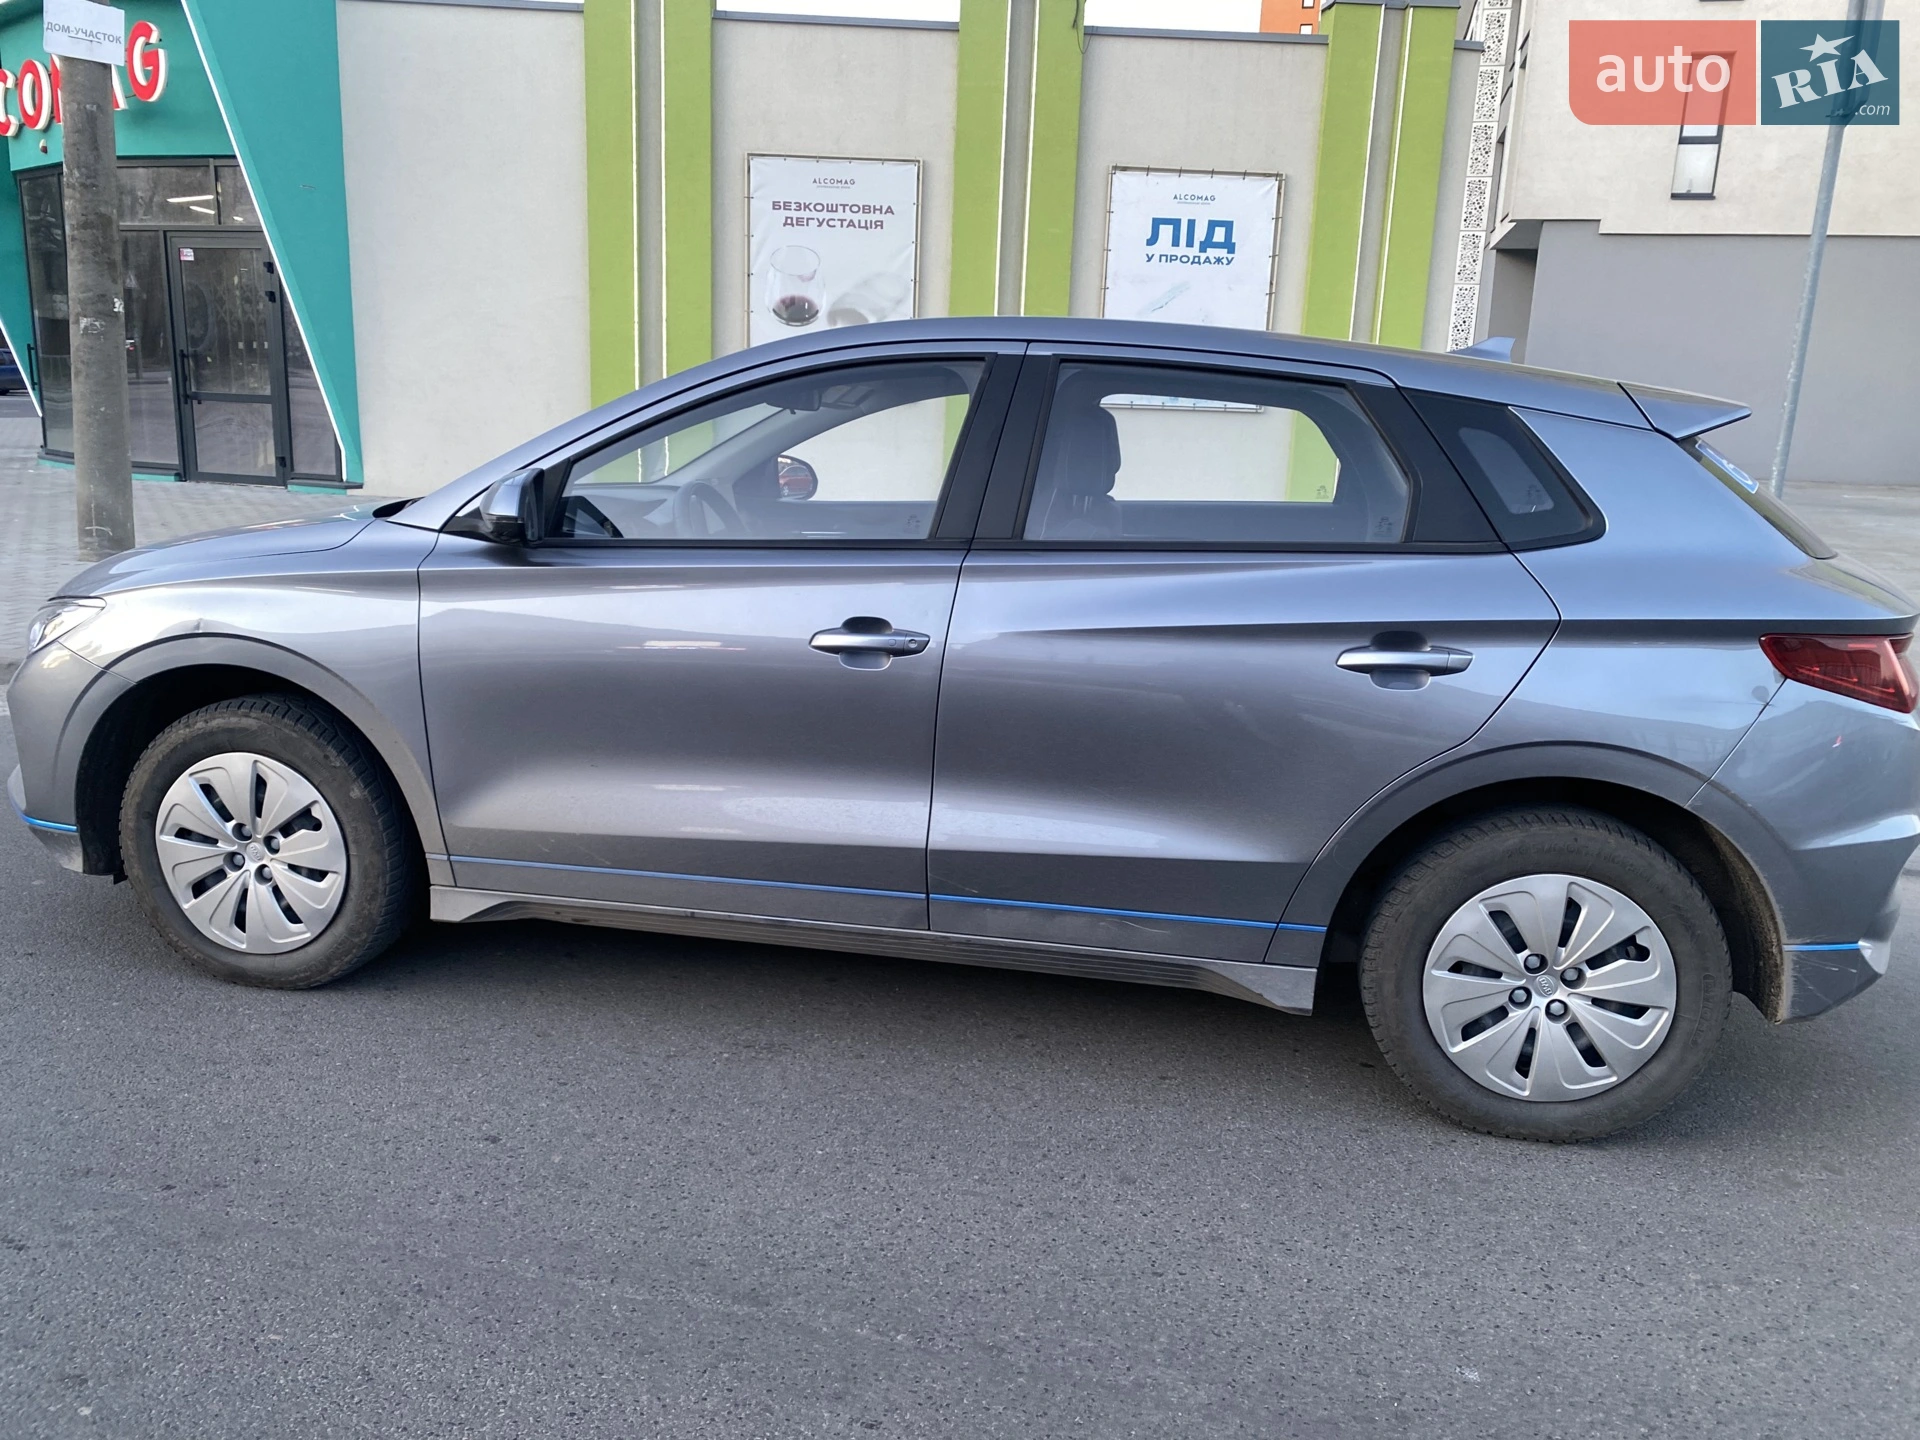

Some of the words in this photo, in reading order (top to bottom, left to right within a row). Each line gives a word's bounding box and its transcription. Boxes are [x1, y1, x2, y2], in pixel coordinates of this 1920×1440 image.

[46, 21, 122, 44] ДОМ-УЧАСТОК
[812, 177, 856, 186] ALCOMAG
[1173, 193, 1216, 202] ALCOMAG
[771, 200, 895, 216] БЕЗКОШТОВНА
[782, 216, 884, 230] ДЕГУСТАЦІЯ
[1146, 217, 1236, 255] ЛІД
[1146, 253, 1155, 263] У
[1158, 253, 1235, 266] ПРОДАЖУ
